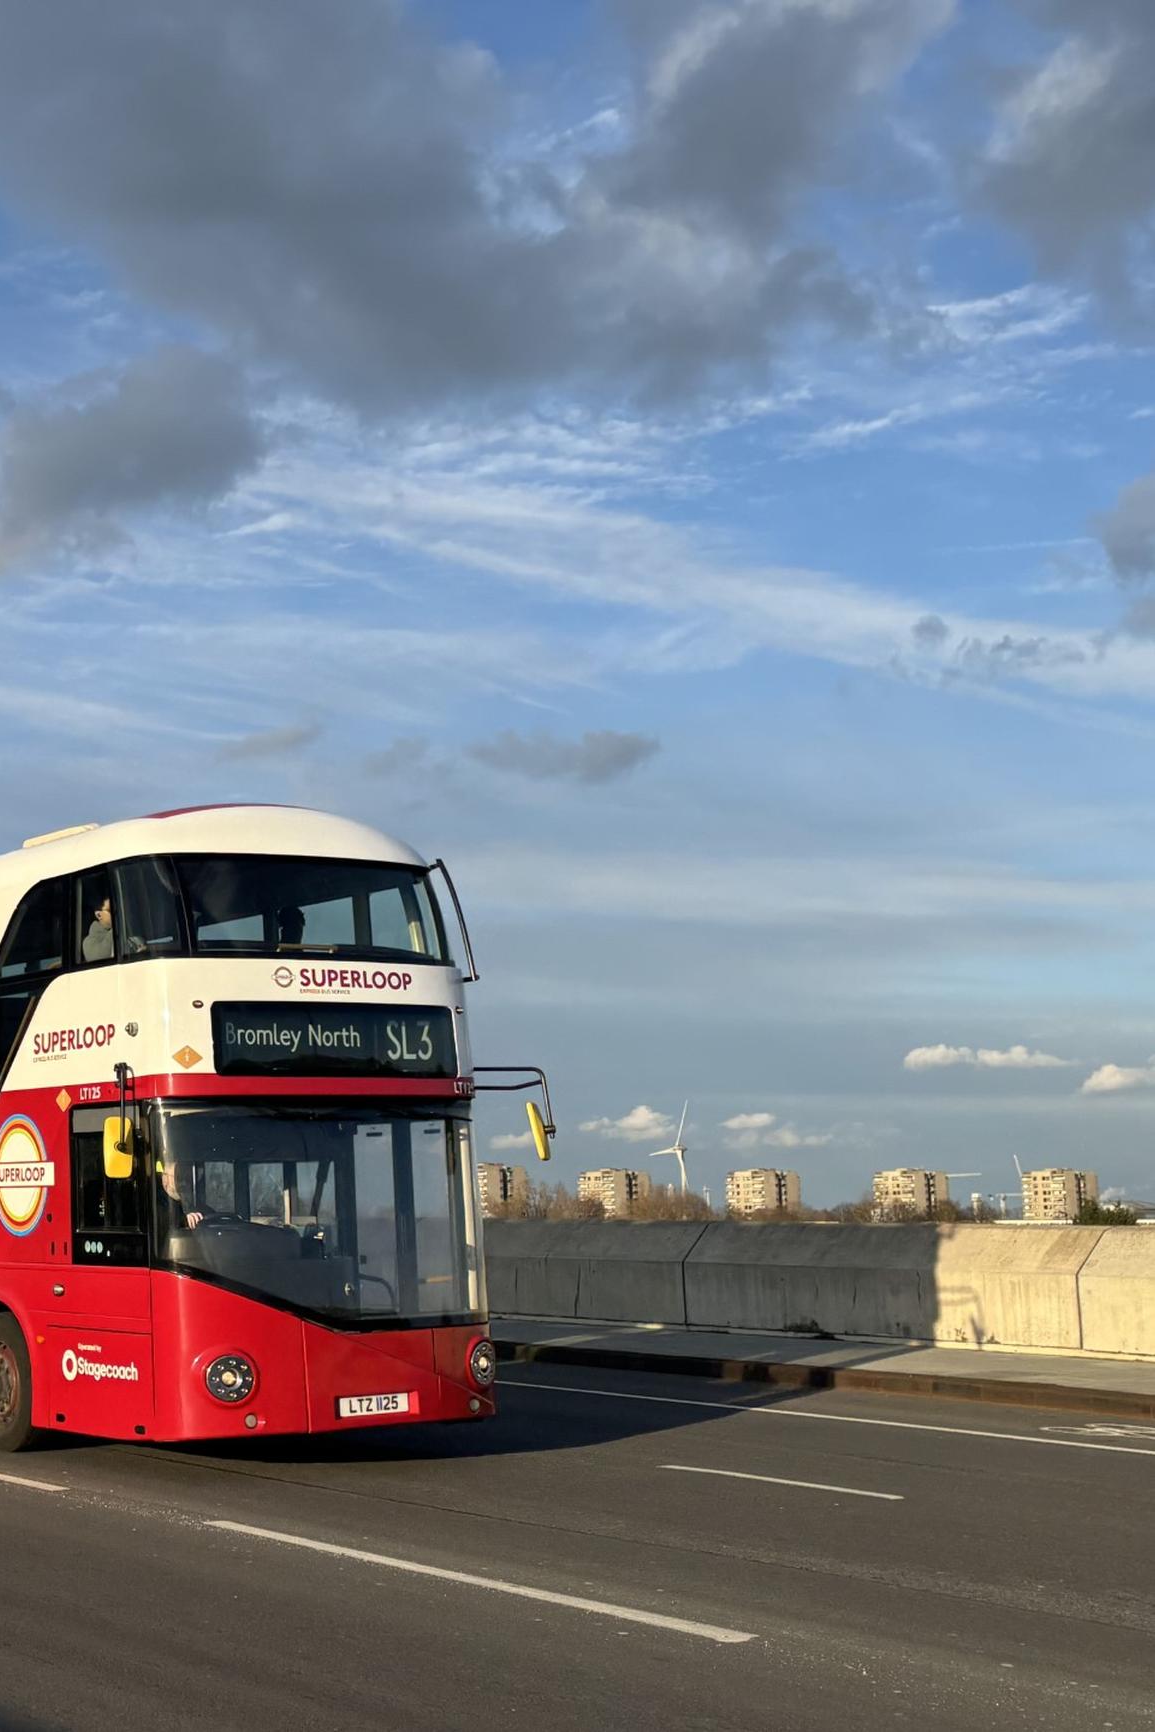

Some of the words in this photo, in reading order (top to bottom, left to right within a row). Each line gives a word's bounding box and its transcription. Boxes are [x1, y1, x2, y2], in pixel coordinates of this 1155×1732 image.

[299, 968, 412, 991] SUPERLOOP
[33, 1023, 115, 1055] SUPERLOOP
[225, 1022, 302, 1053] Bromley
[308, 1024, 361, 1048] North
[386, 1020, 434, 1061] SL3
[79, 1086, 101, 1101] LT125
[77, 1356, 139, 1381] Stagecoach
[349, 1397, 373, 1414] LTZ
[376, 1395, 399, 1412] 1125
